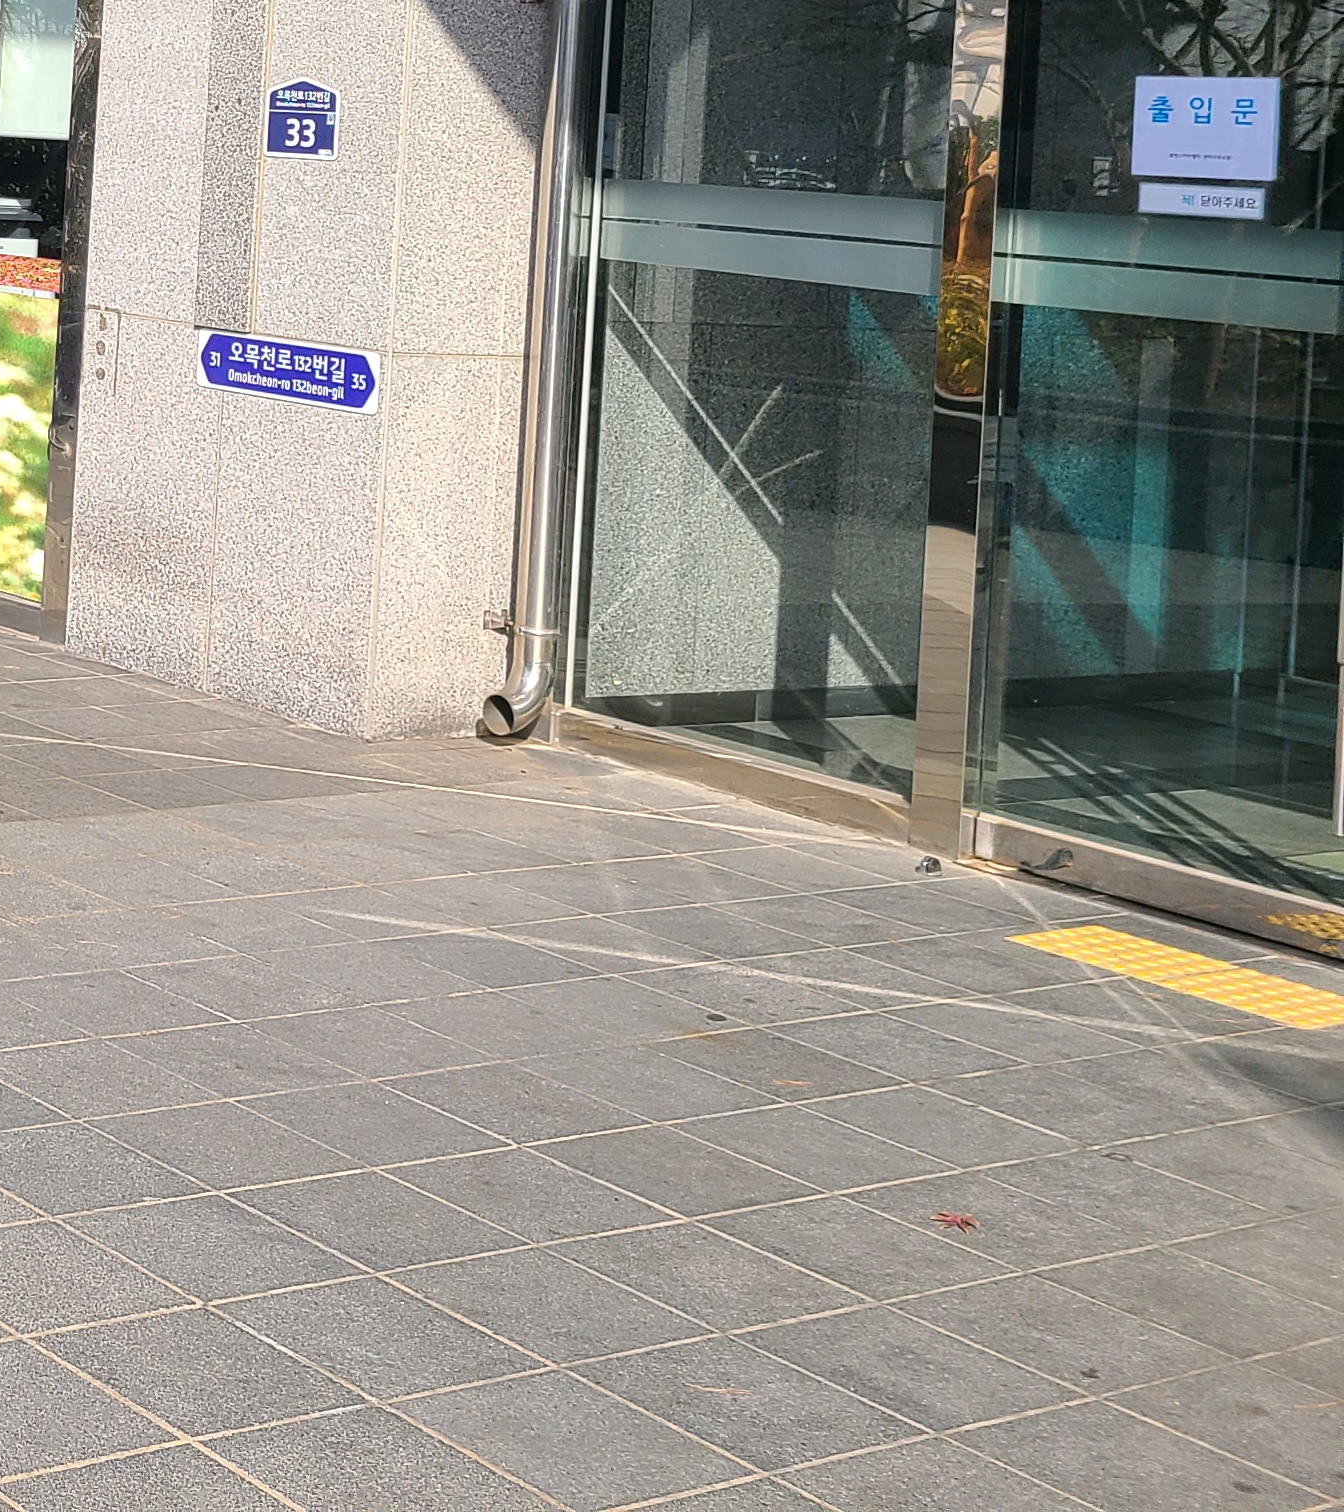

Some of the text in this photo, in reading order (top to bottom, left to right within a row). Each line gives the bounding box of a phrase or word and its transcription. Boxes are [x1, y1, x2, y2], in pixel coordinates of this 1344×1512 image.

[284, 118, 316, 148] 33
[209, 351, 221, 368] 31
[228, 341, 346, 384] 오목천로132번길
[228, 368, 345, 401] Omokcheon-ro 132beon-gil
[351, 373, 367, 391] 35
